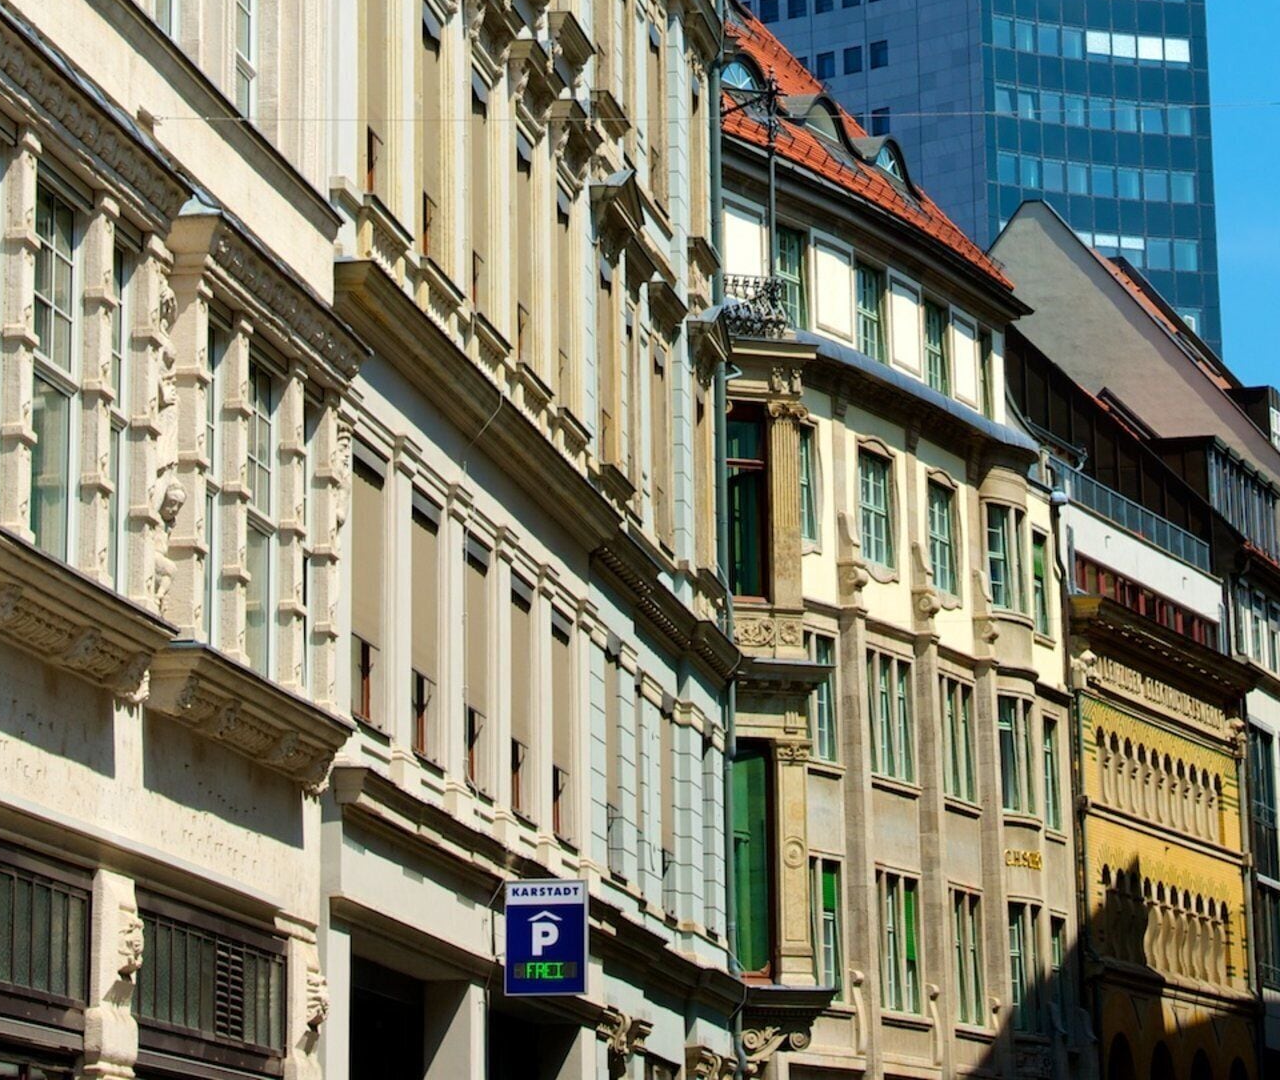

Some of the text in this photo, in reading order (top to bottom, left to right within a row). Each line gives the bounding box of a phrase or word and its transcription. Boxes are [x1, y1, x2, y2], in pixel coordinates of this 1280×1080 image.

[511, 886, 580, 897] KARSTADT
[531, 921, 560, 956] P
[526, 962, 564, 979] FREI
